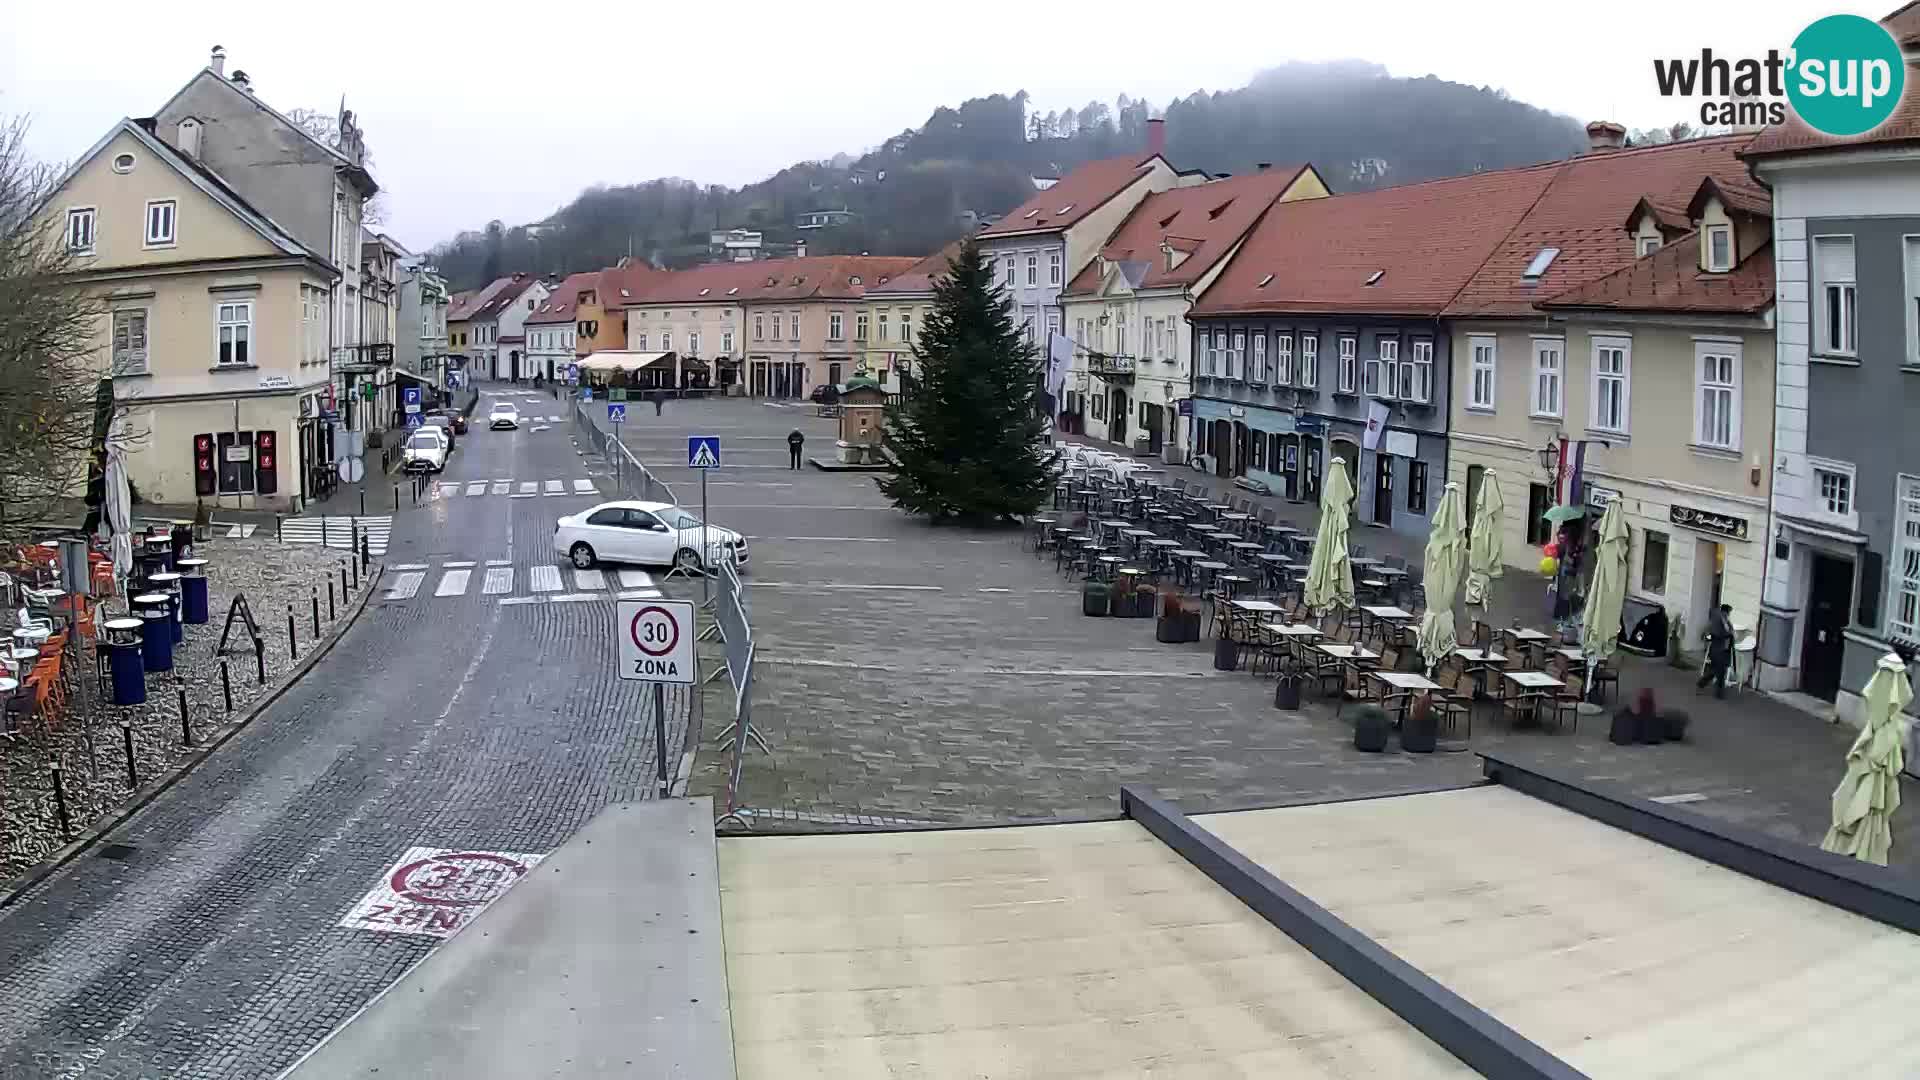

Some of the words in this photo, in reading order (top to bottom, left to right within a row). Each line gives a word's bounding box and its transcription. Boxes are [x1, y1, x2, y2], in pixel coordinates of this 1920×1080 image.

[408, 391, 416, 402] P
[643, 622, 668, 643] 30
[634, 659, 678, 676] ZONA
